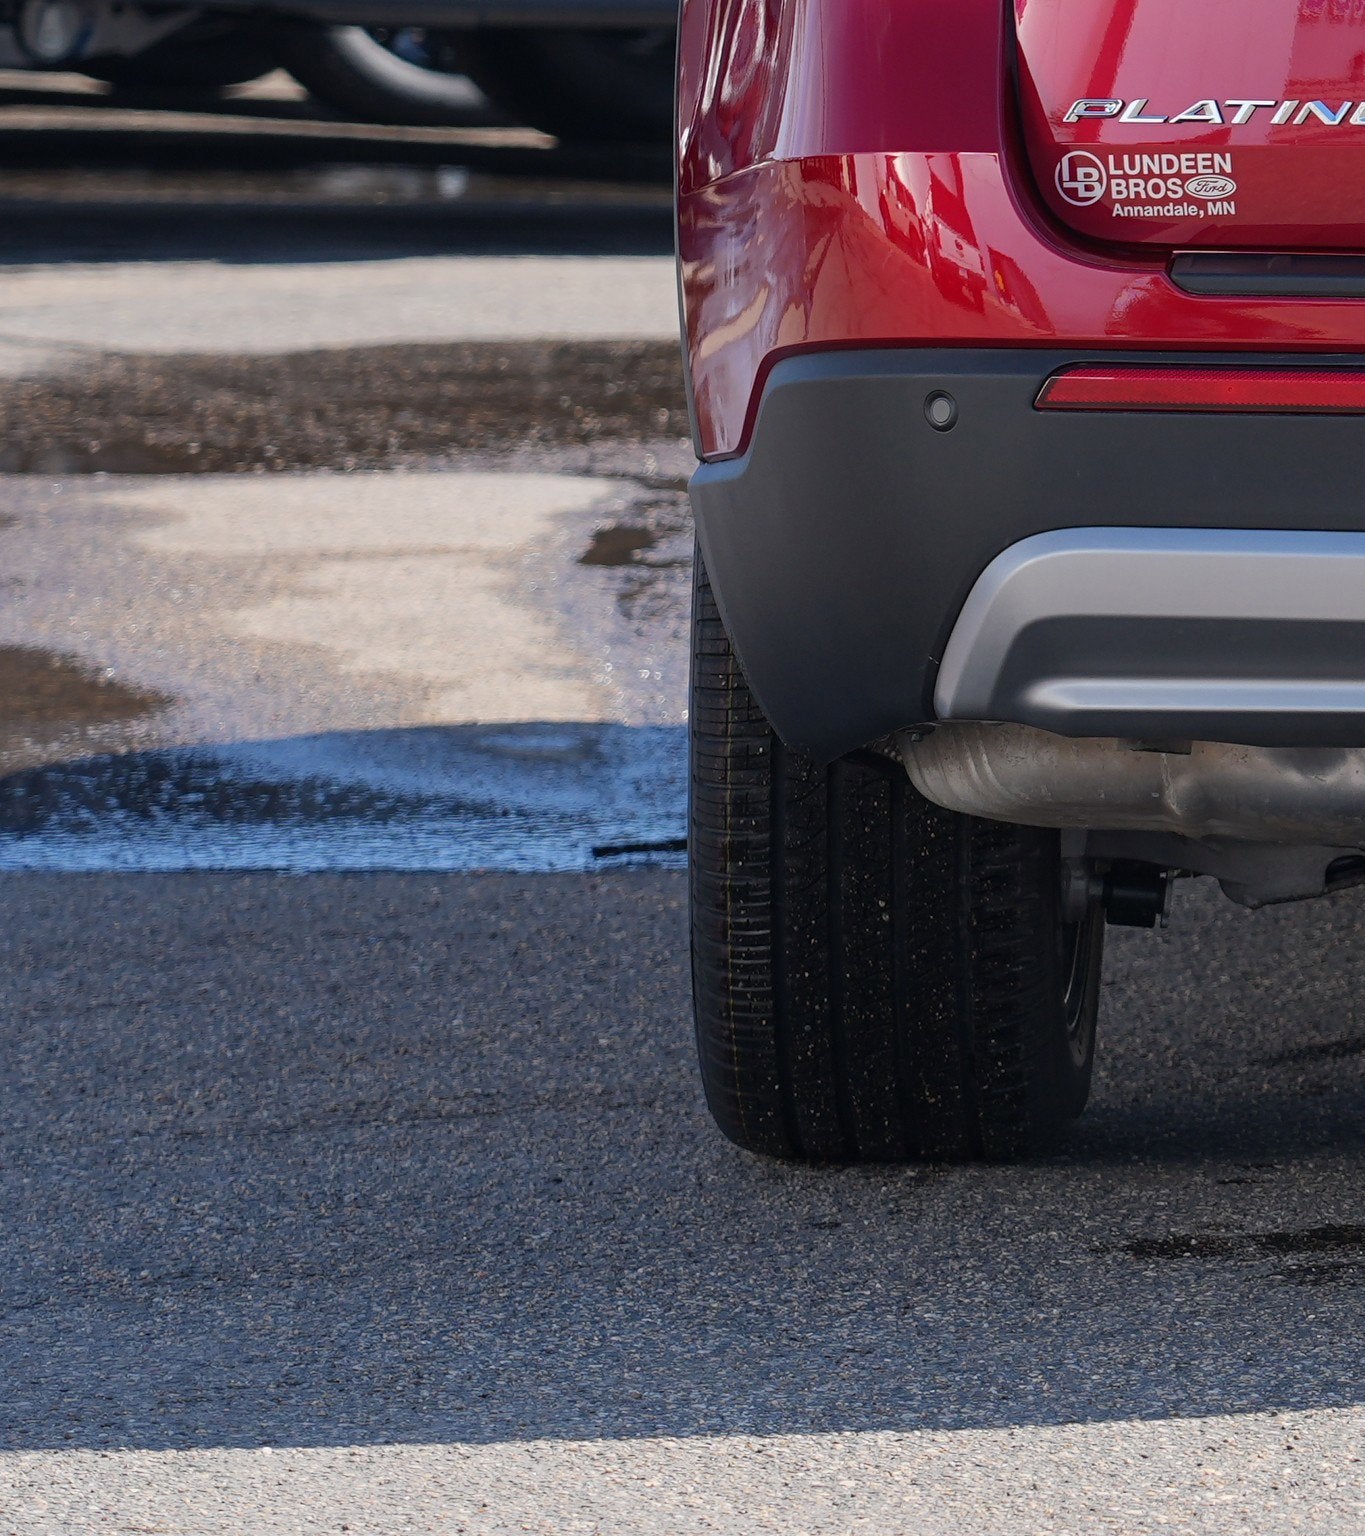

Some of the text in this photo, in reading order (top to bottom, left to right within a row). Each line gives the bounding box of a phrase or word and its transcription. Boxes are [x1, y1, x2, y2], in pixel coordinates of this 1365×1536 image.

[1107, 152, 1233, 175] LUNDEEN
[1109, 177, 1184, 200] BROS
[1111, 200, 1236, 219] Annandale, MN
